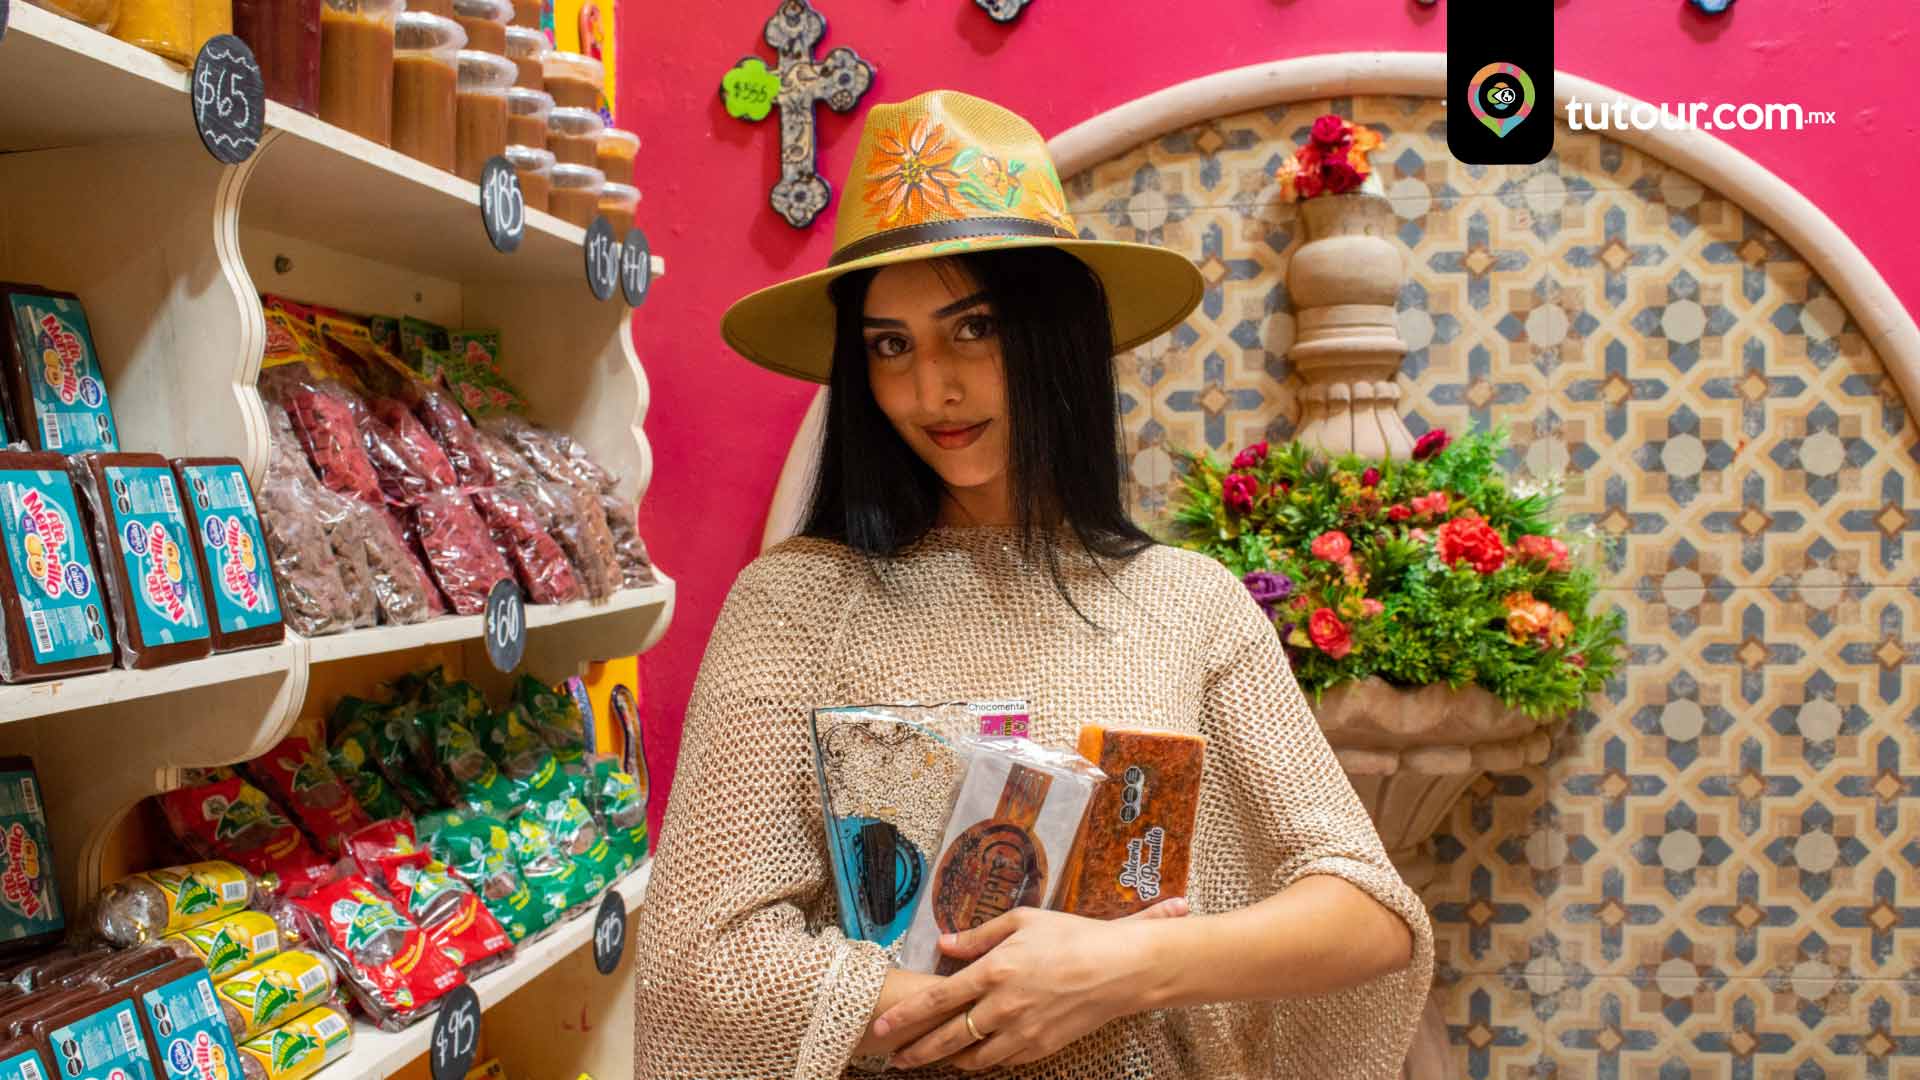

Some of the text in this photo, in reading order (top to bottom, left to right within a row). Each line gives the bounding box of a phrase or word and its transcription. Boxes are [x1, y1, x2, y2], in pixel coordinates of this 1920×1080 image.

[195, 63, 249, 128] $65
[483, 168, 524, 236] $185
[590, 233, 619, 287] $130
[622, 244, 648, 293] $70
[24, 491, 62, 596] Membrillo
[151, 524, 185, 621] Membrillo
[228, 518, 258, 608] Membrillo
[488, 595, 519, 647] $60
[968, 703, 1025, 711] Chocomenta
[1140, 829, 1162, 899] El Panalito
[595, 912, 622, 956] $95
[436, 1000, 474, 1068] $95
